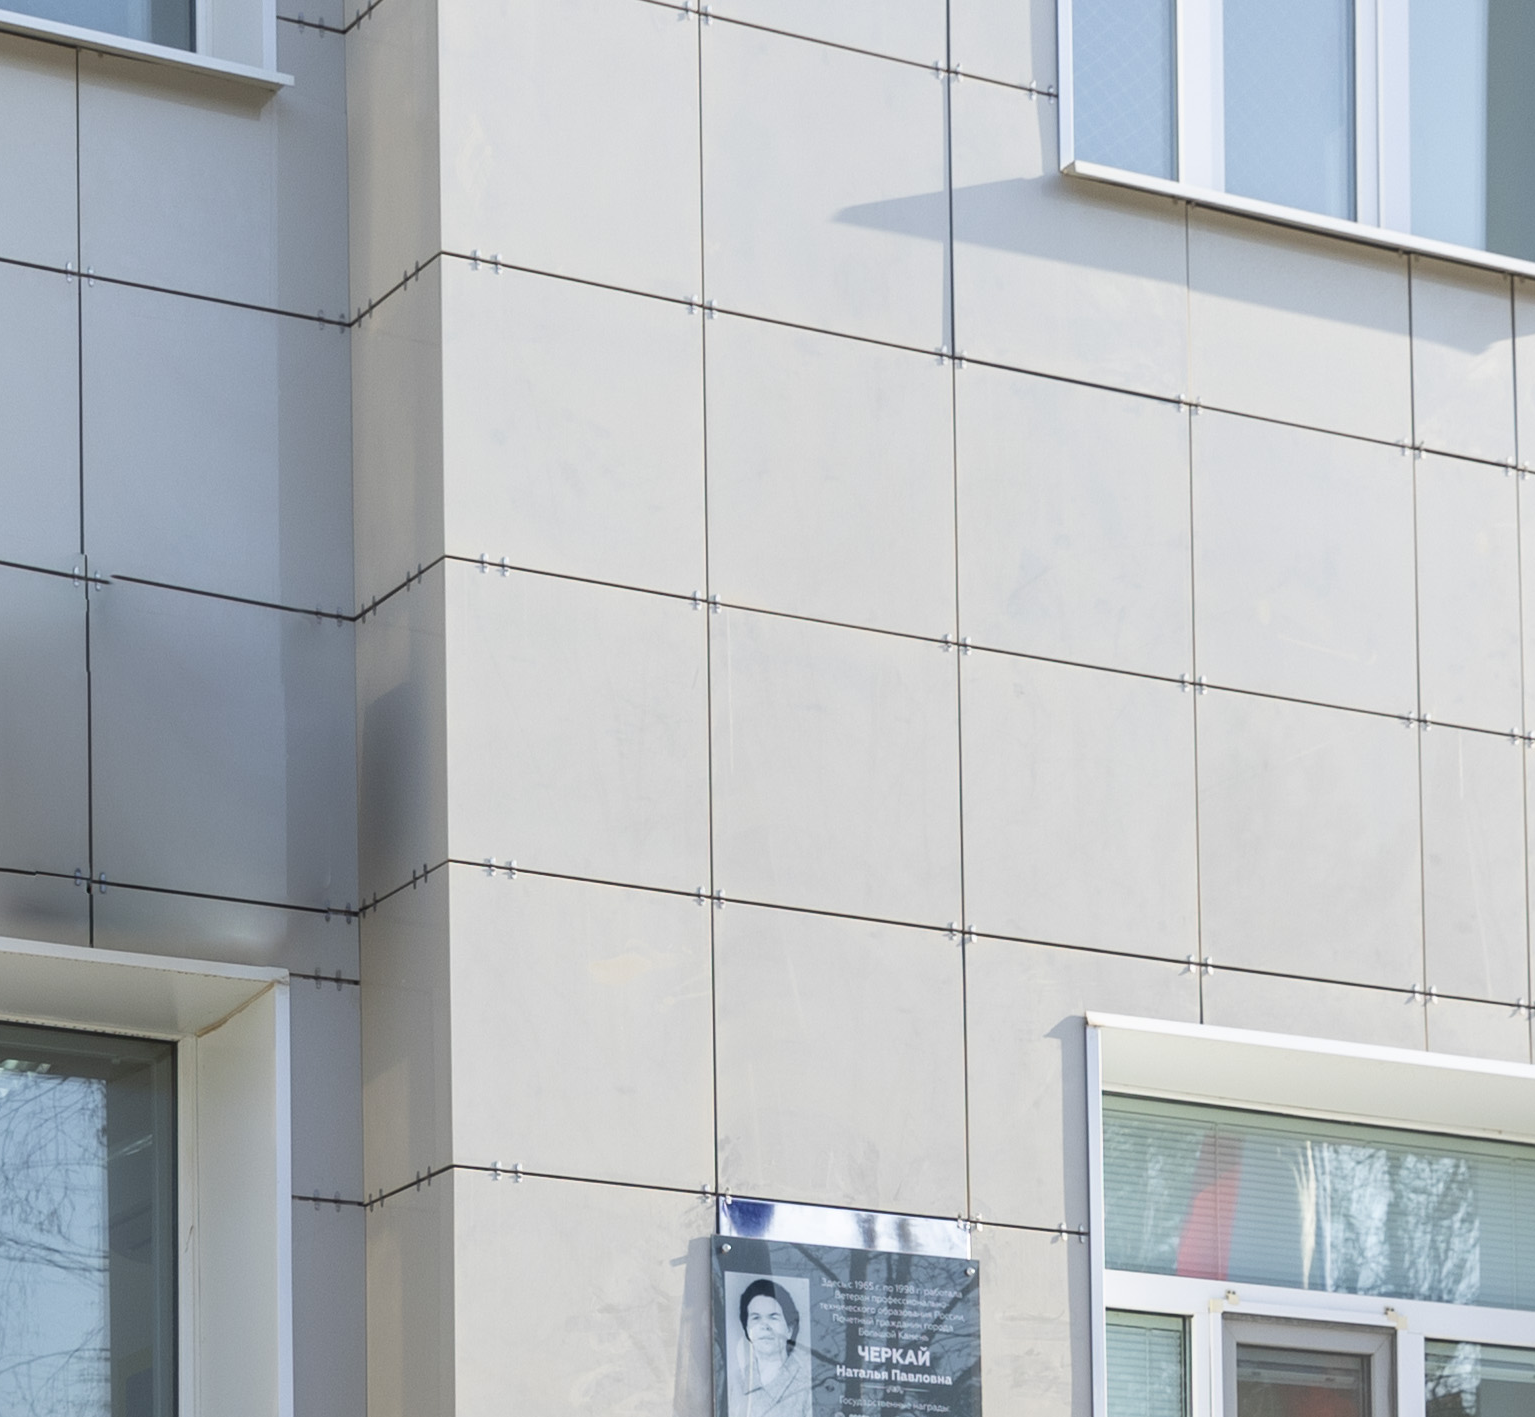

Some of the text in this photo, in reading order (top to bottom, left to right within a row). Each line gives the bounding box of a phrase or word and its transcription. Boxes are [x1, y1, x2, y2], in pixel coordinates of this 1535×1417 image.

[855, 1280, 874, 1291] 1965
[857, 1345, 930, 1366] ЧЕРКАЙ
[836, 1364, 953, 1386] Наталья Павловна
